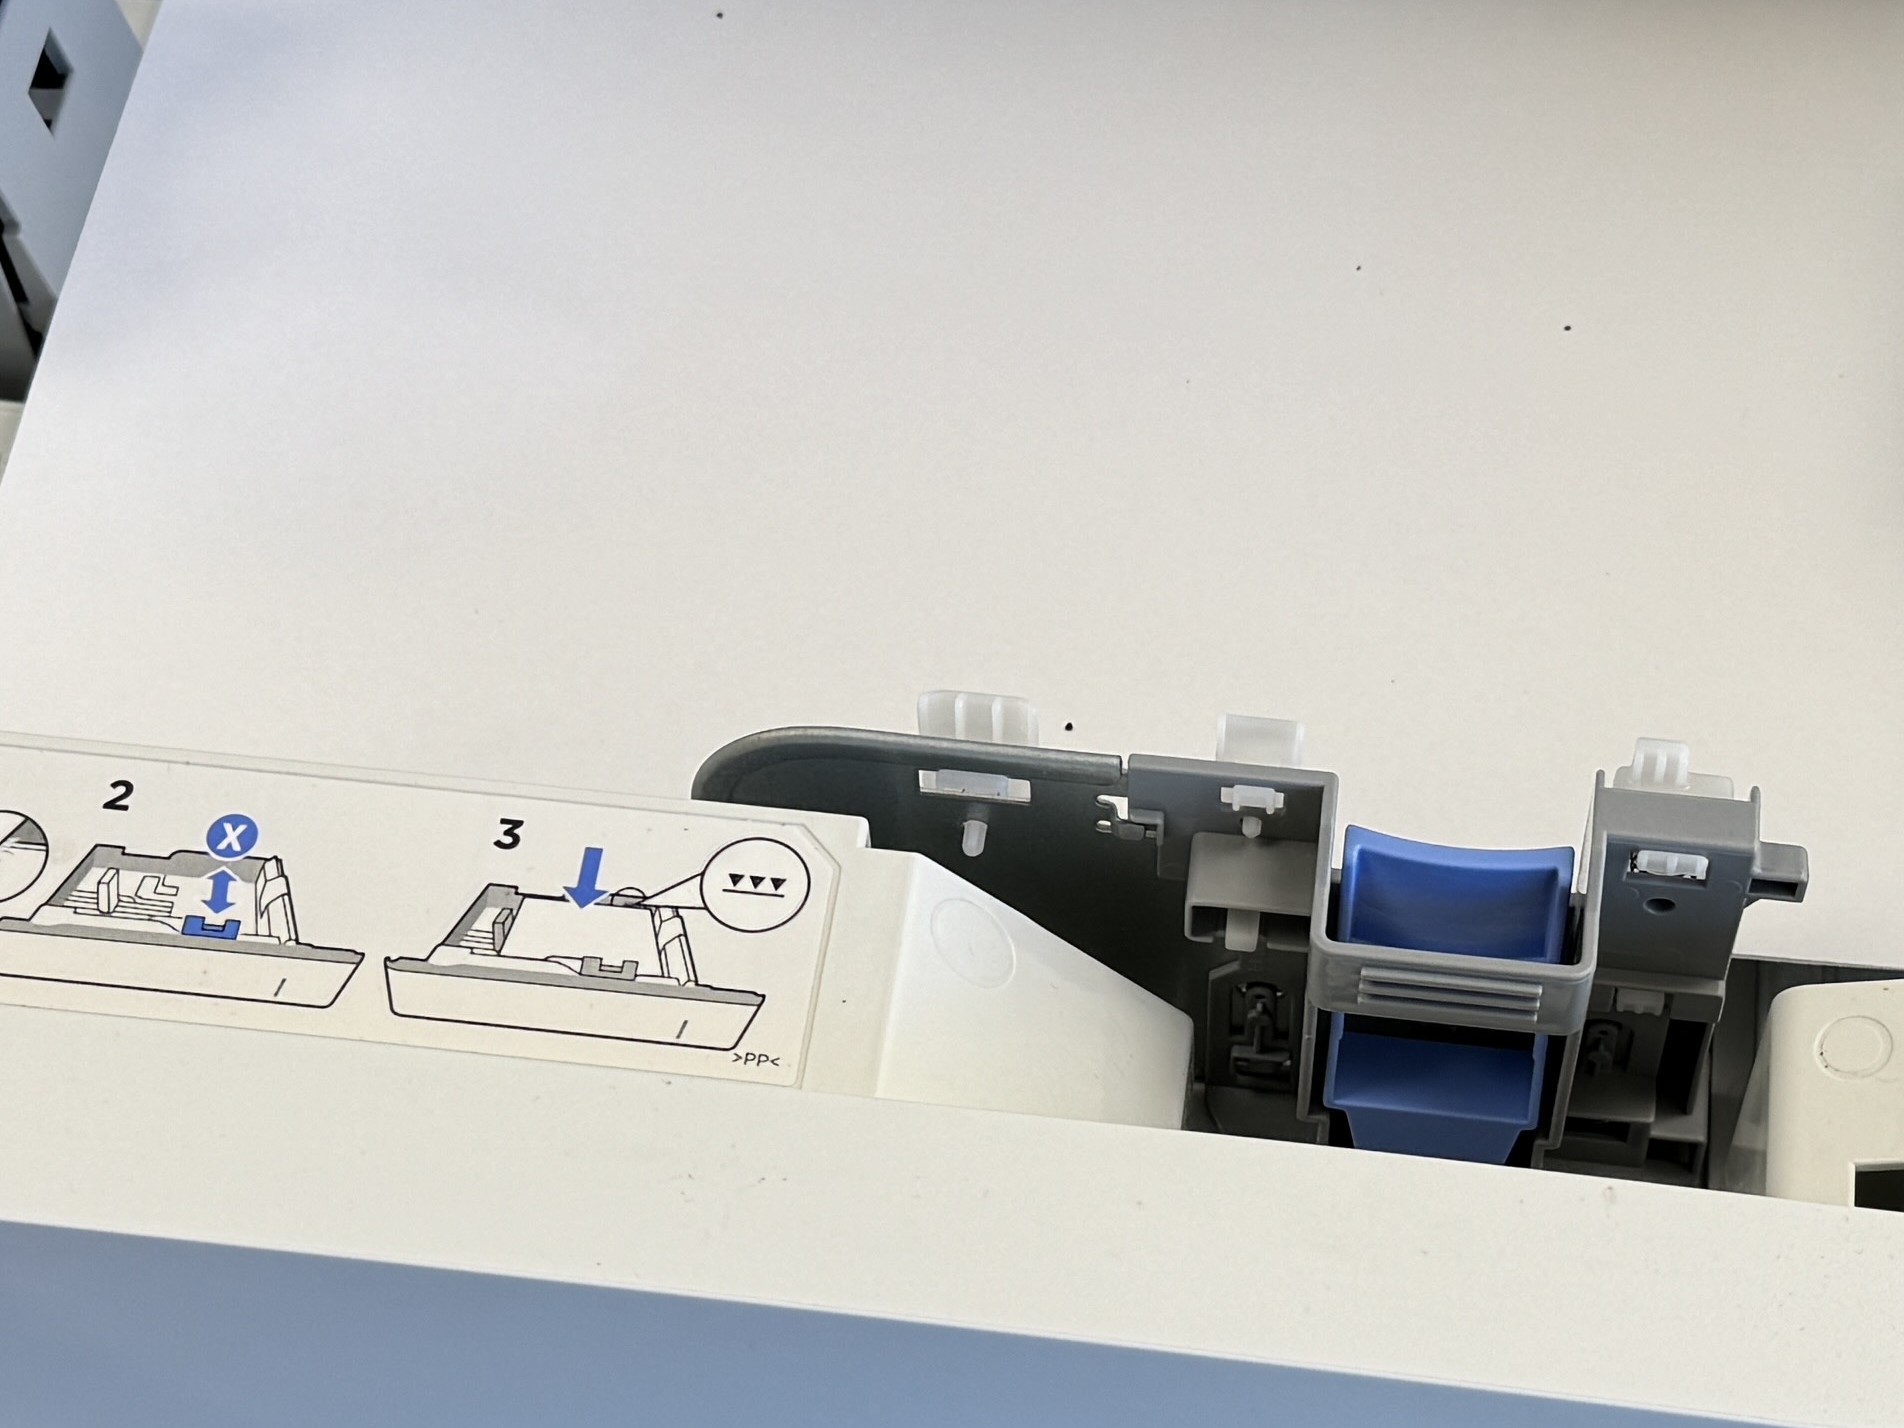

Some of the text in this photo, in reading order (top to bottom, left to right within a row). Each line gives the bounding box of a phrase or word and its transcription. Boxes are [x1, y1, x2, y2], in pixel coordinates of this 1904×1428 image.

[101, 779, 135, 811] 2
[216, 822, 247, 850] X
[493, 818, 524, 850] 3
